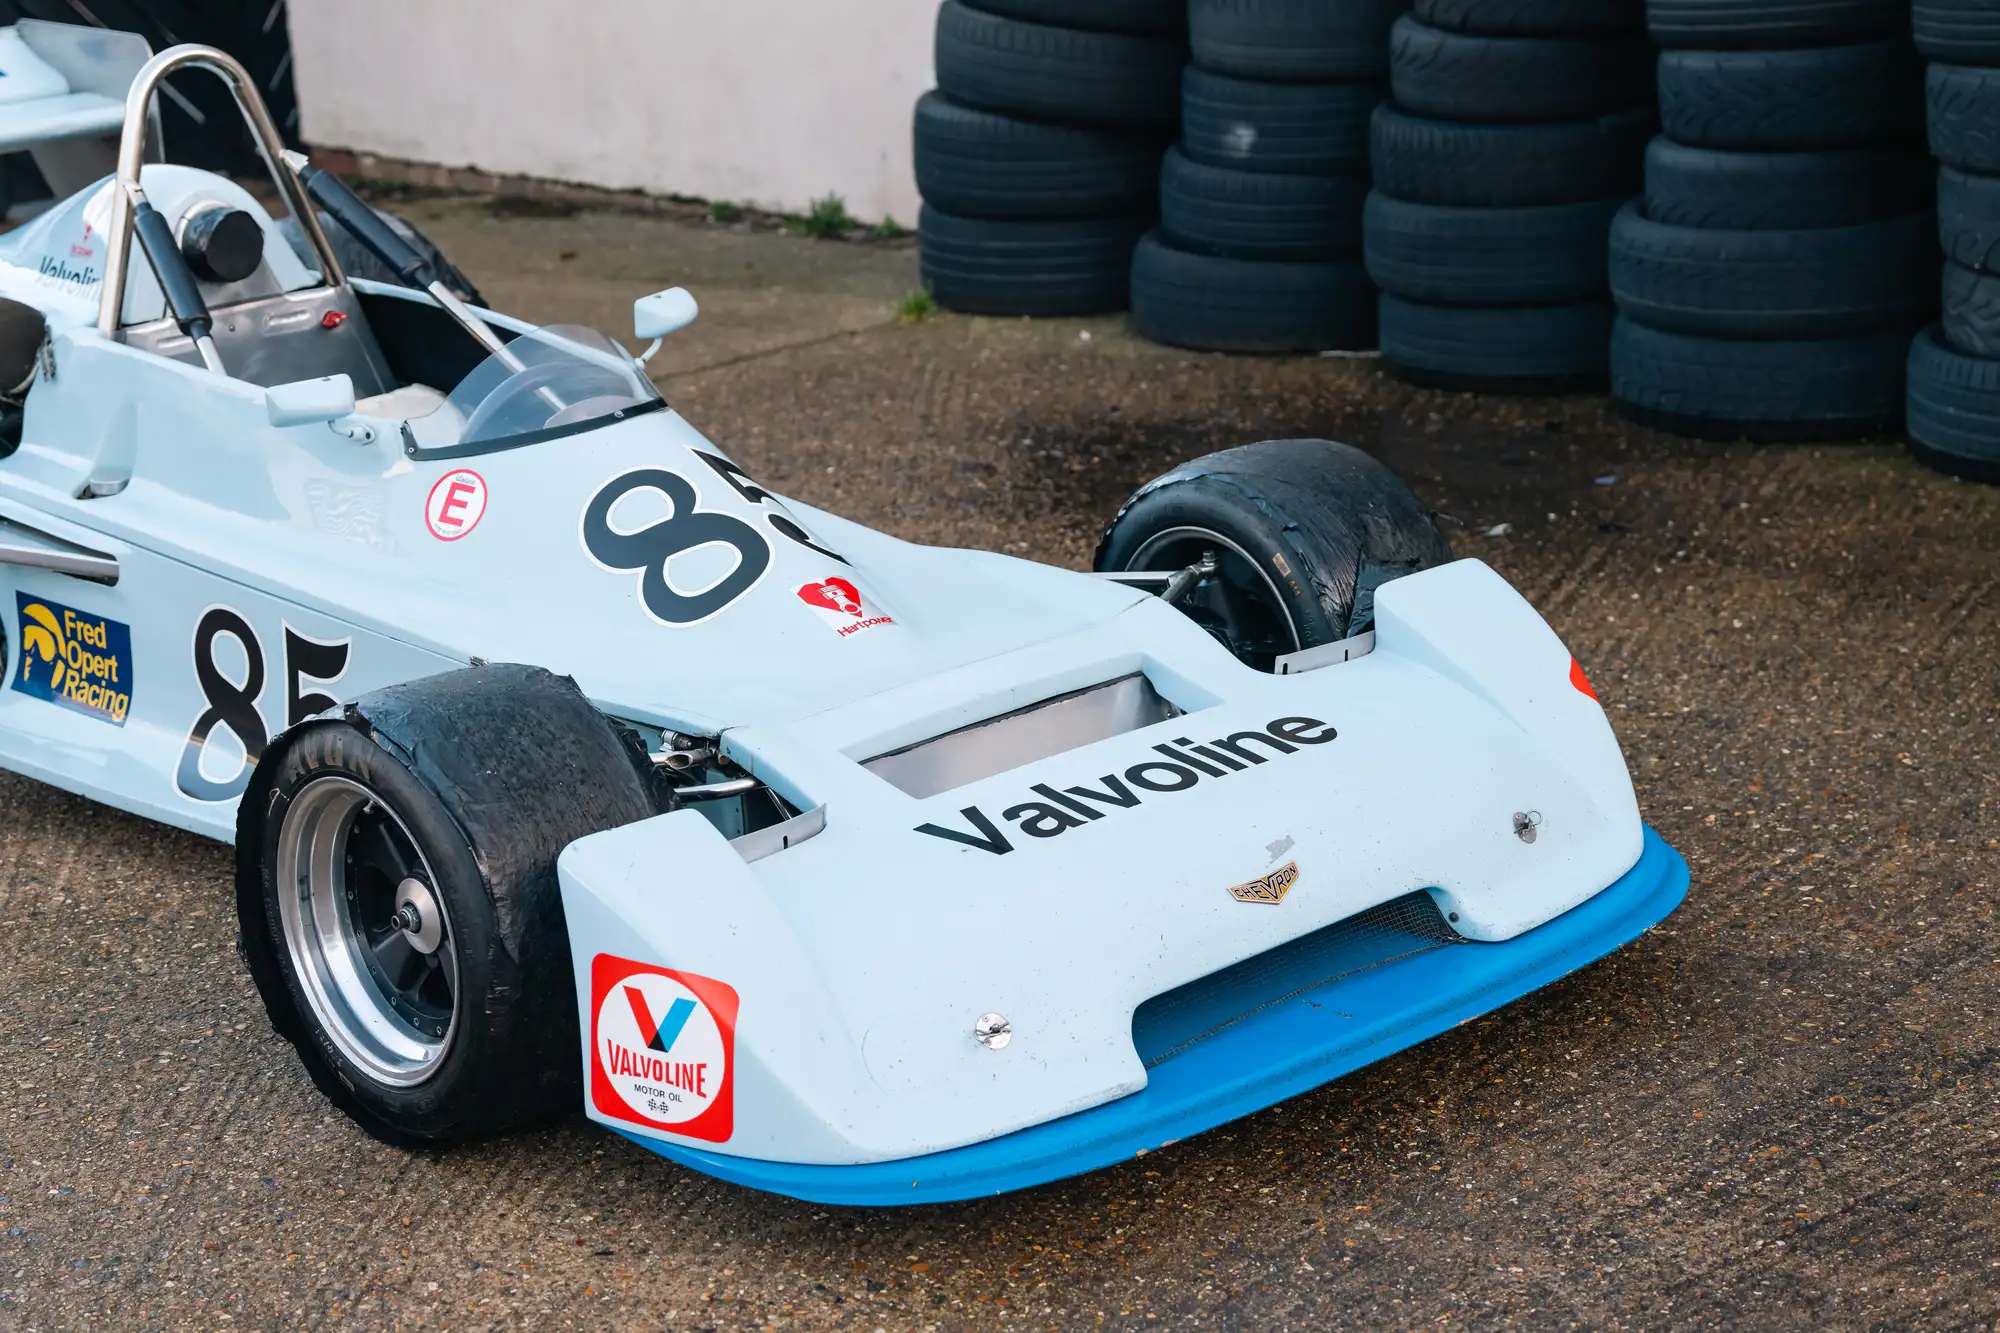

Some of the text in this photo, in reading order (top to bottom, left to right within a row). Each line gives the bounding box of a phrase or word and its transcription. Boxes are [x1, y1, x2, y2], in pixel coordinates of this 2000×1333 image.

[36, 255, 101, 301] Valvolin
[438, 482, 476, 527] E
[64, 610, 107, 649] Fred
[67, 640, 119, 682] Opert
[62, 669, 129, 722] Racing
[913, 716, 1338, 855] Valvoline
[1233, 865, 1297, 900] CHEVRON
[607, 1038, 707, 1099] VALVOLINE
[633, 1083, 684, 1103] MOTOR OIL
